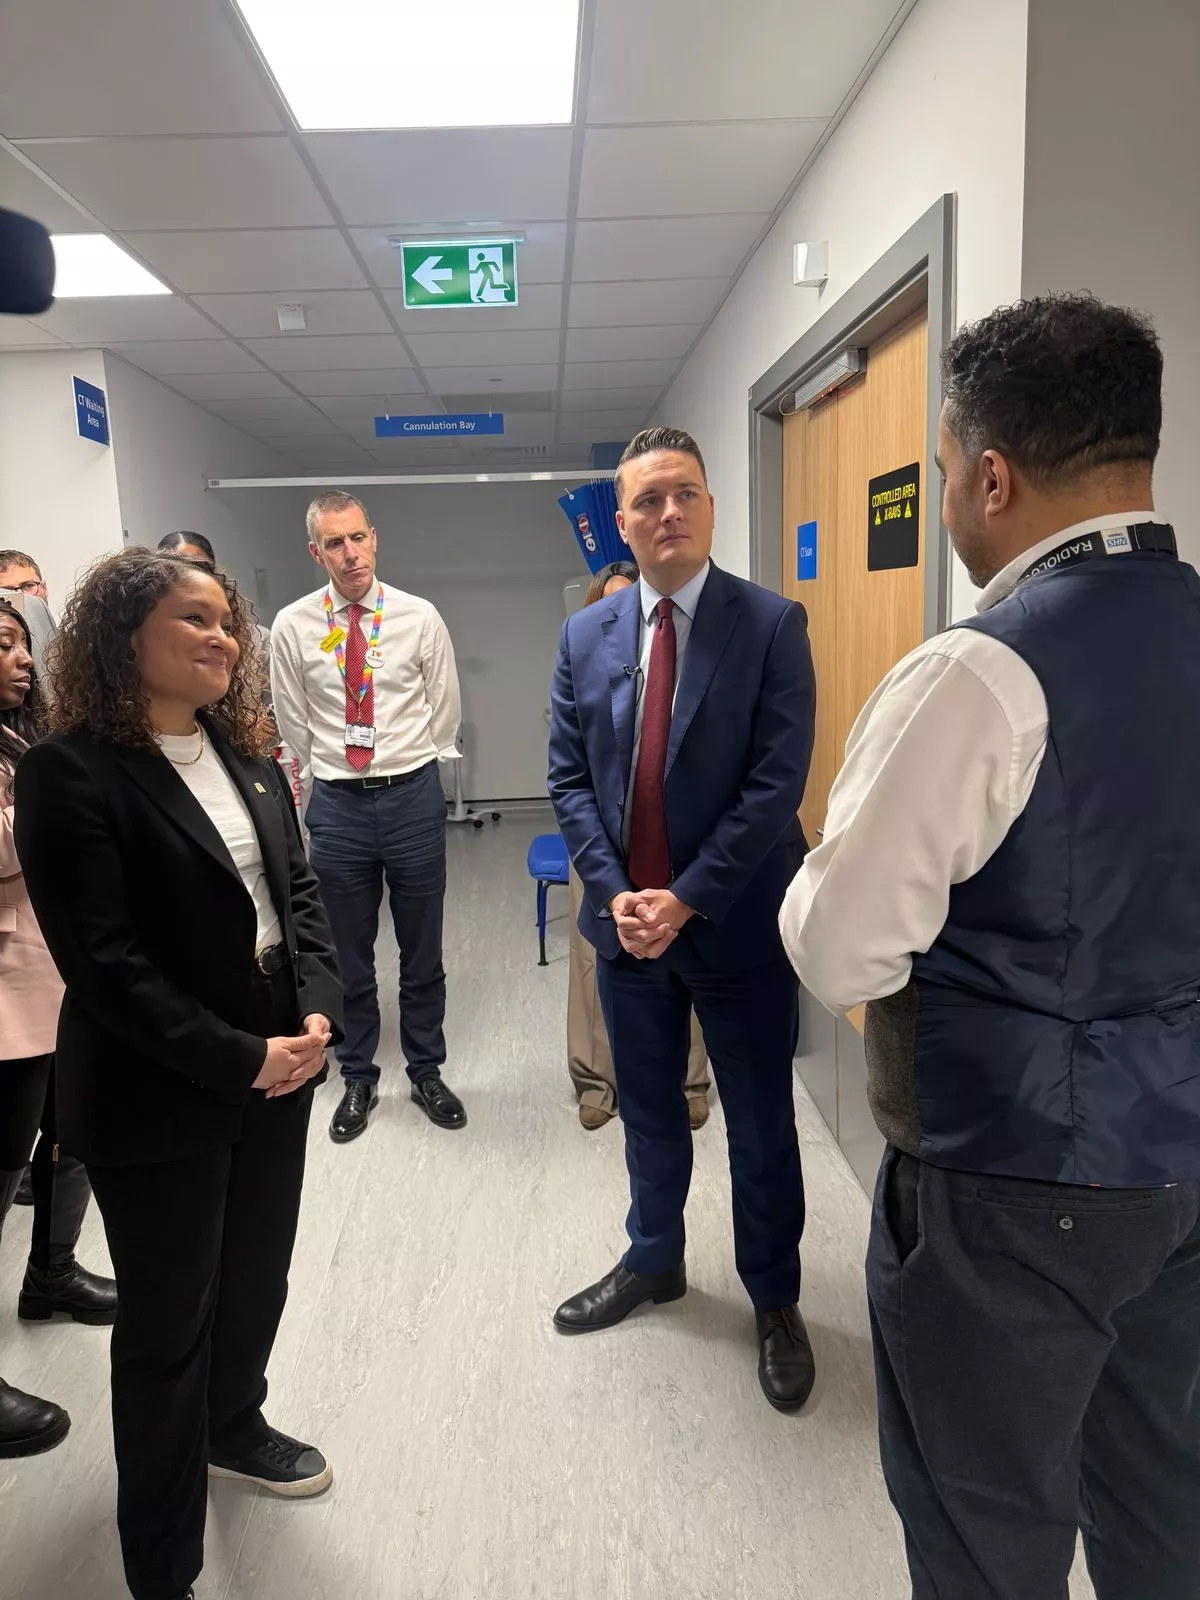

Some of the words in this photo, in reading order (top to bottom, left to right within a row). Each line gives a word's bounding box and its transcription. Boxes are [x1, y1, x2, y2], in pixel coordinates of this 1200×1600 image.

[78, 394, 85, 406] CT
[85, 396, 105, 418] Waiting
[87, 413, 100, 428] Area
[404, 420, 457, 431] Cannulation
[459, 420, 476, 431] Bay
[872, 487, 902, 508] CONTROLLED
[901, 483, 917, 499] AREA
[1107, 537, 1127, 547] NHS
[1026, 540, 1093, 577] RADIOLO
